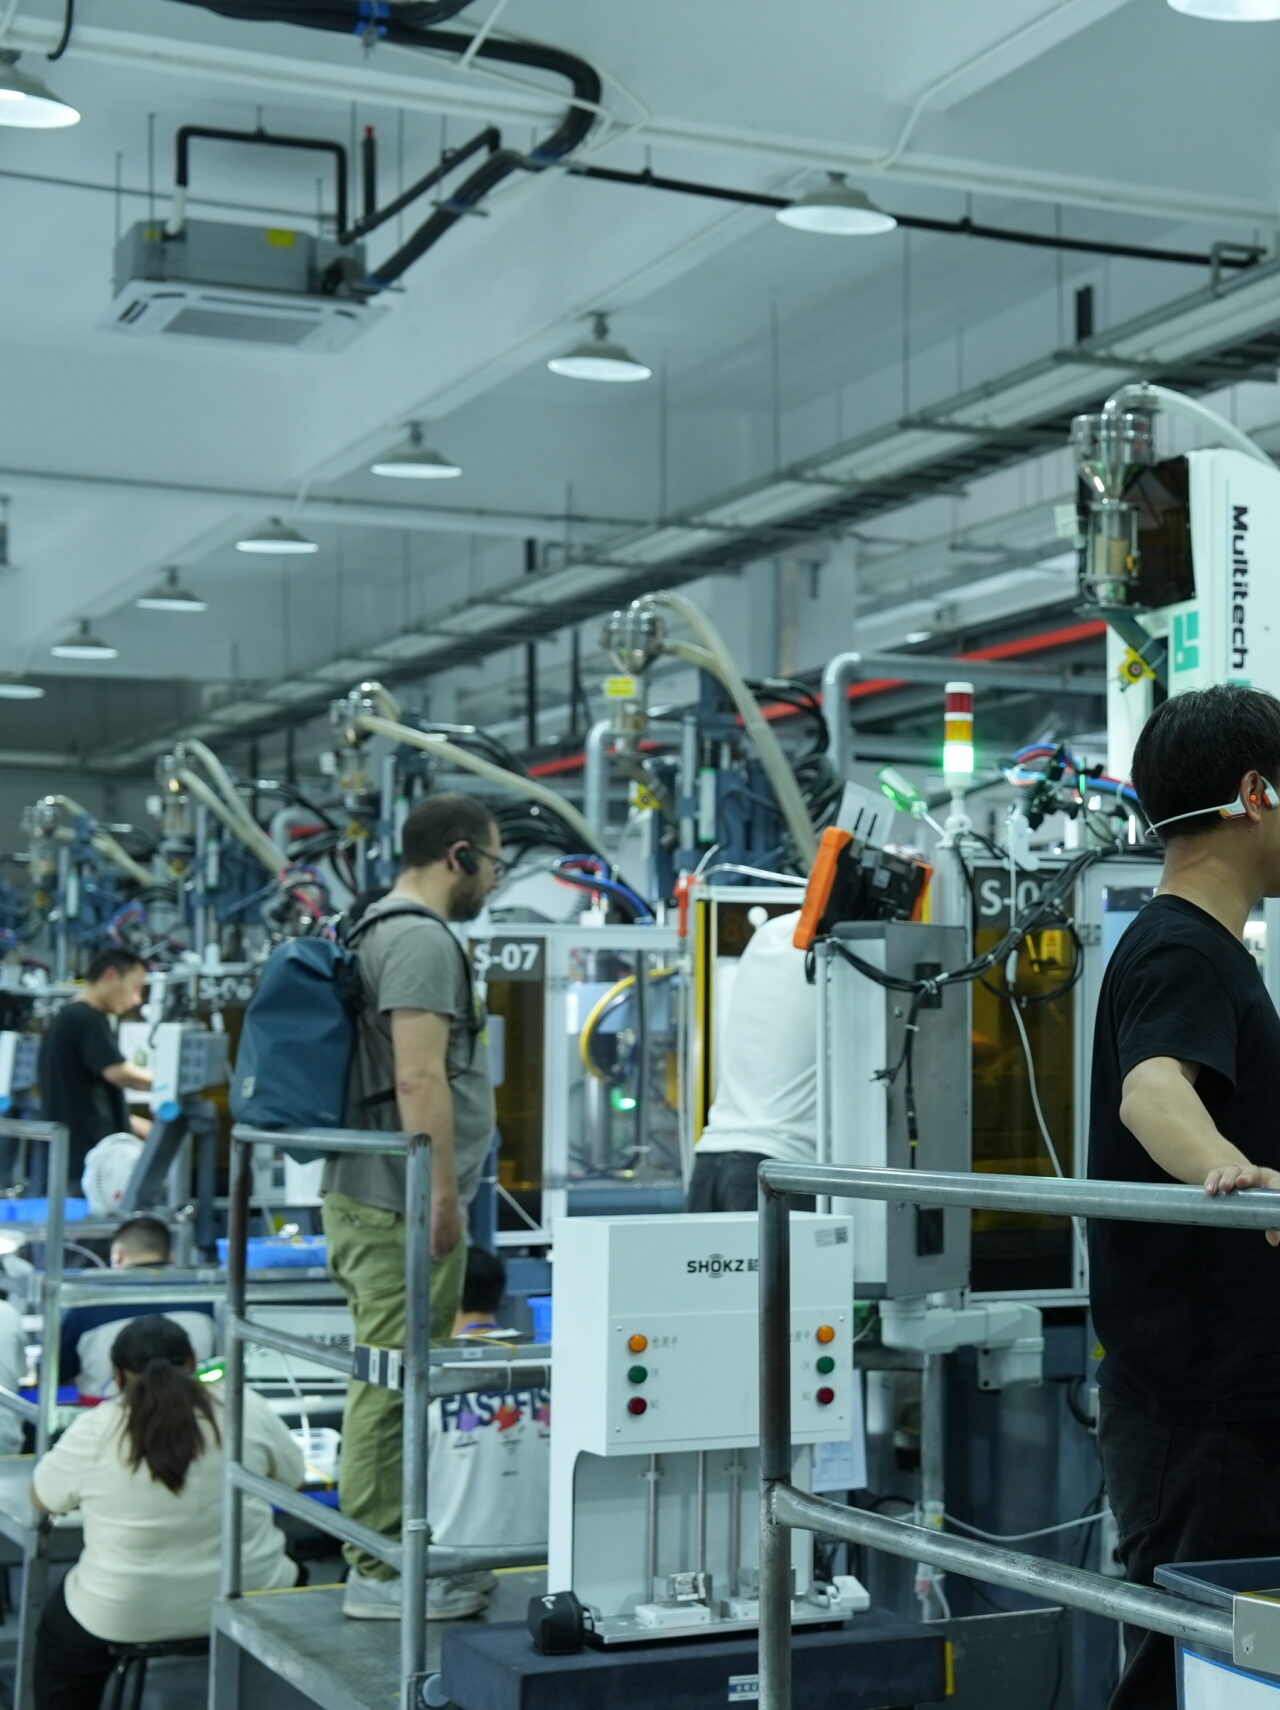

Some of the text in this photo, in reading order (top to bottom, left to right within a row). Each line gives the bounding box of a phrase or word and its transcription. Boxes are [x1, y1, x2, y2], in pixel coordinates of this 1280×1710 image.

[1232, 505, 1248, 669] Multitech
[980, 879, 1058, 916] S-0
[473, 943, 539, 971] S-07
[687, 1258, 744, 1274] SHOKZ
